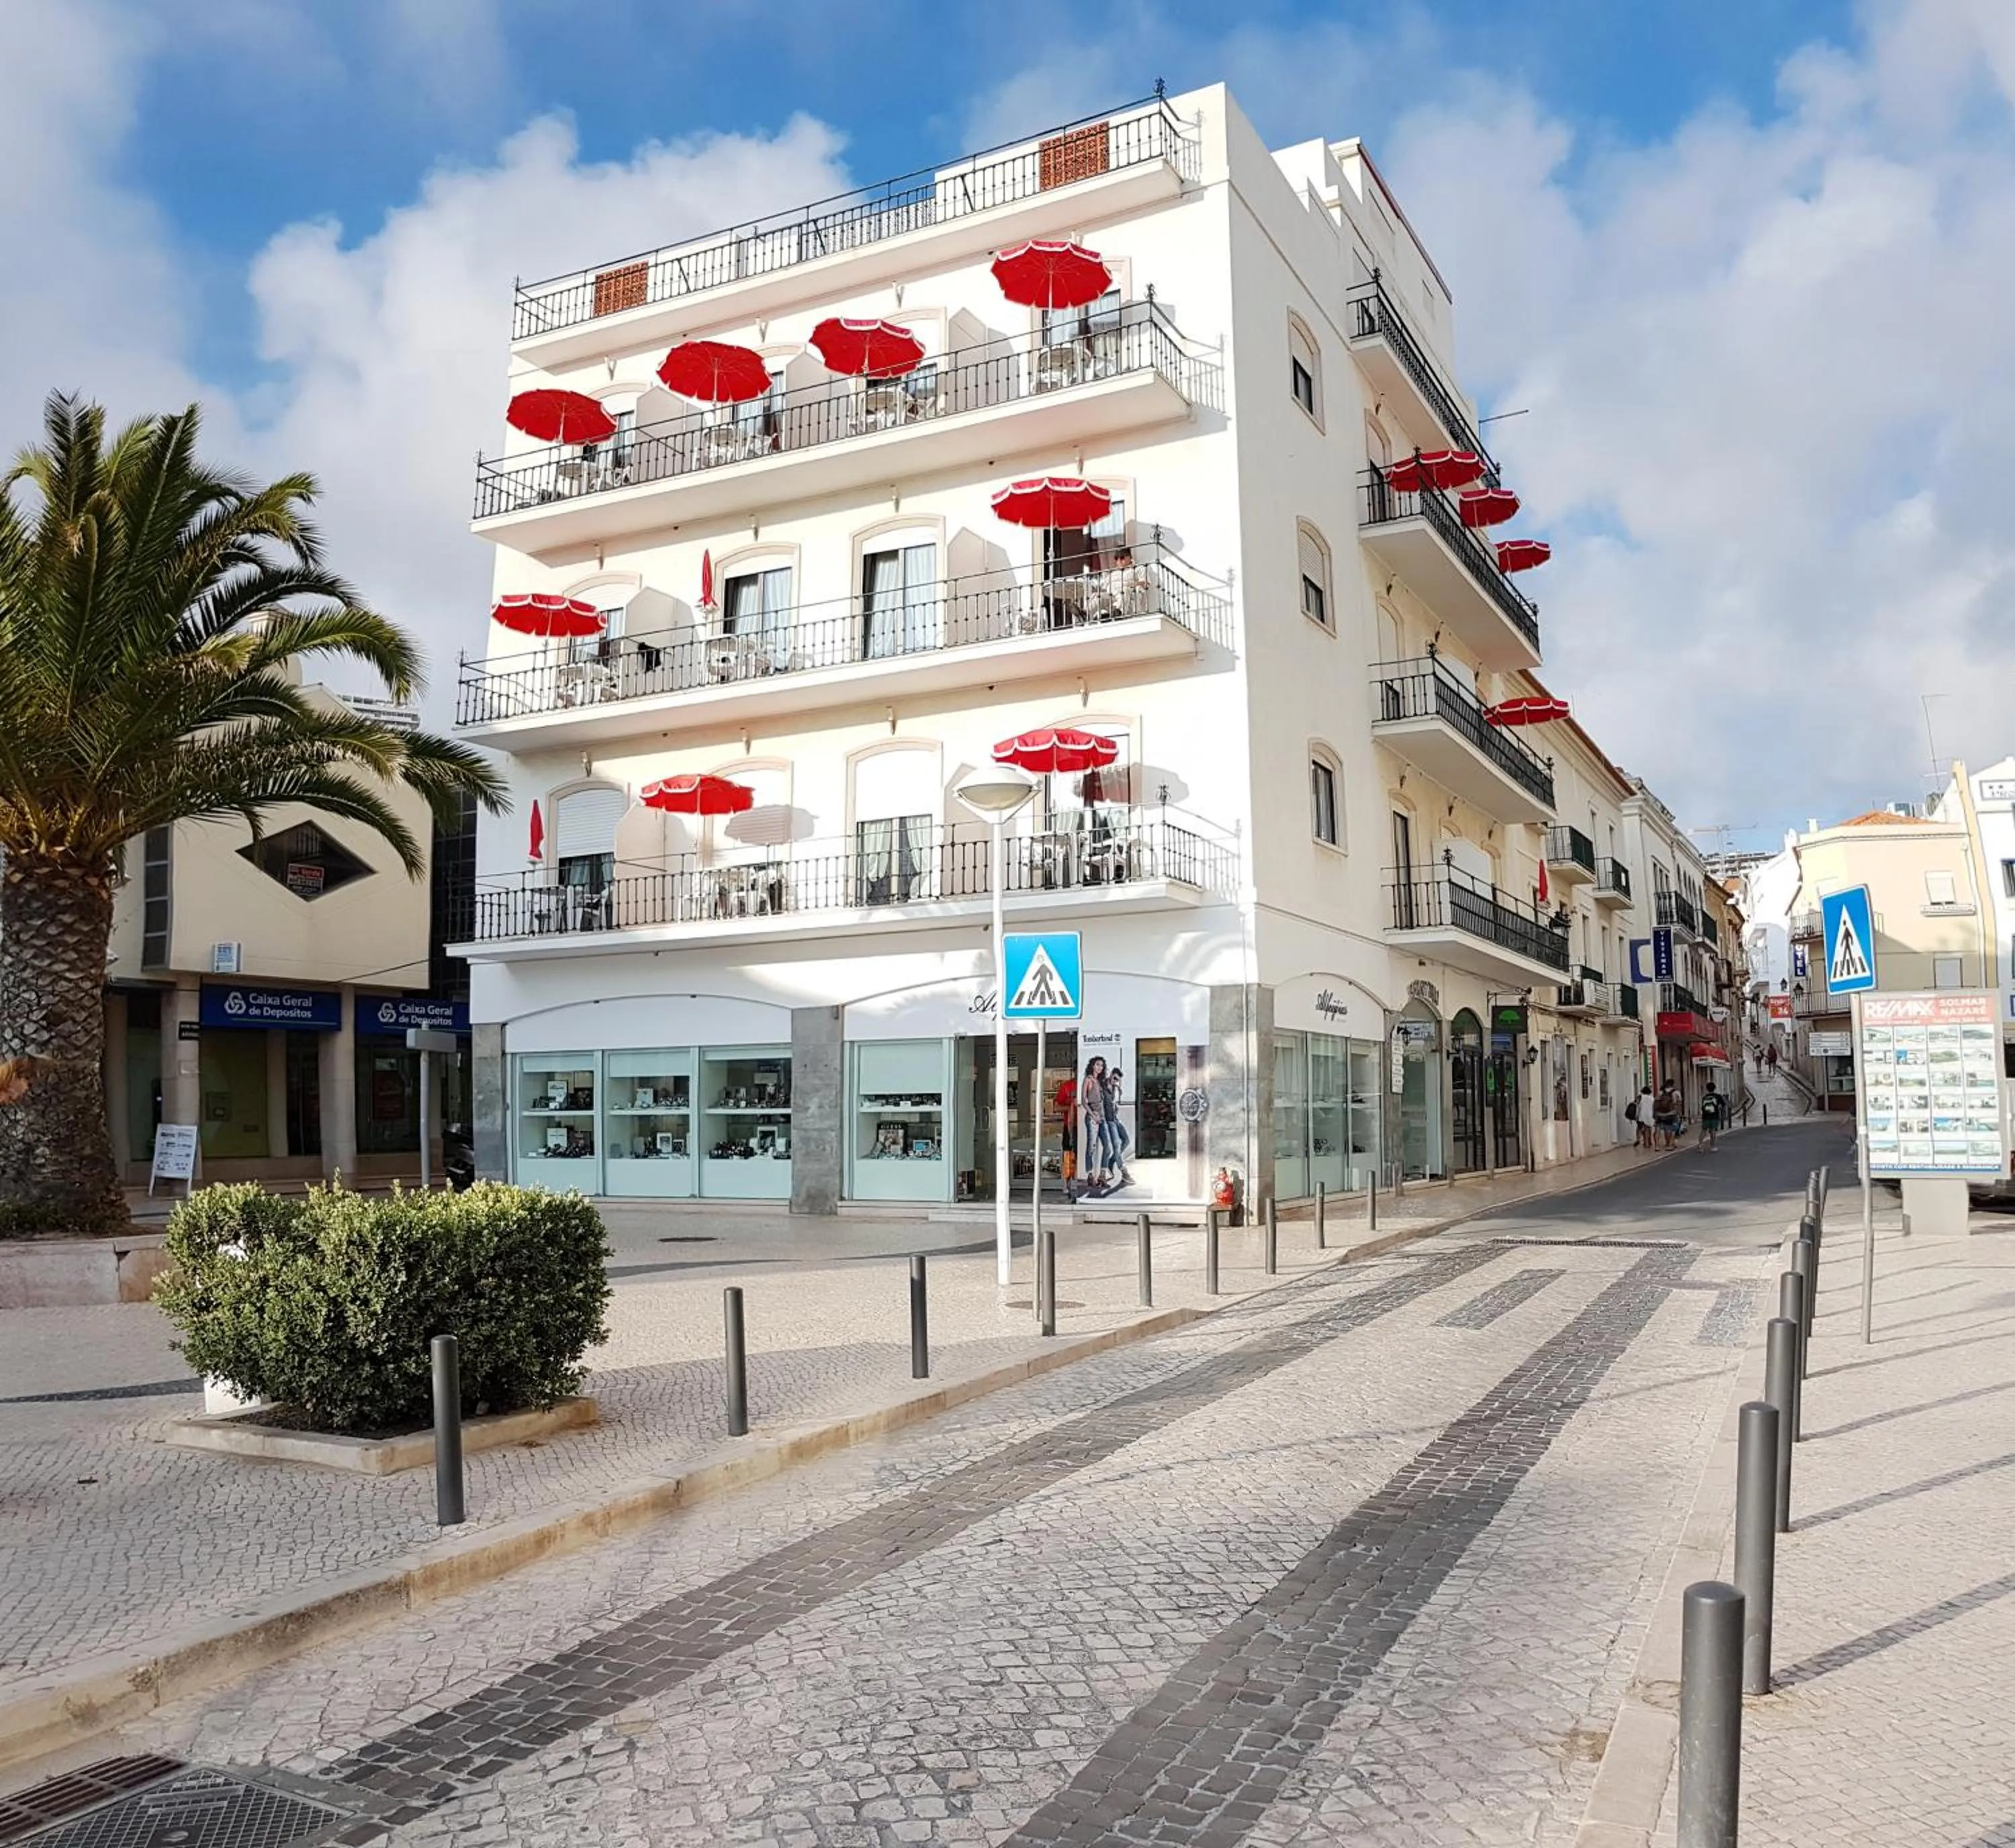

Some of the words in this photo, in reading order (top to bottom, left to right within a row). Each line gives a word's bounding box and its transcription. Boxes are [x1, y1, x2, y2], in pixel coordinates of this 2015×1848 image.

[1795, 938, 1803, 976] OTEL
[249, 992, 280, 1005] Caixa
[283, 995, 312, 1007] Geral
[249, 1007, 261, 1016] de
[399, 1003, 425, 1014] Caixa
[427, 1005, 453, 1016] Geral
[1865, 999, 1934, 1018] RE/MAX
[1938, 998, 1986, 1007] SOLMAR
[399, 1015, 409, 1023] de
